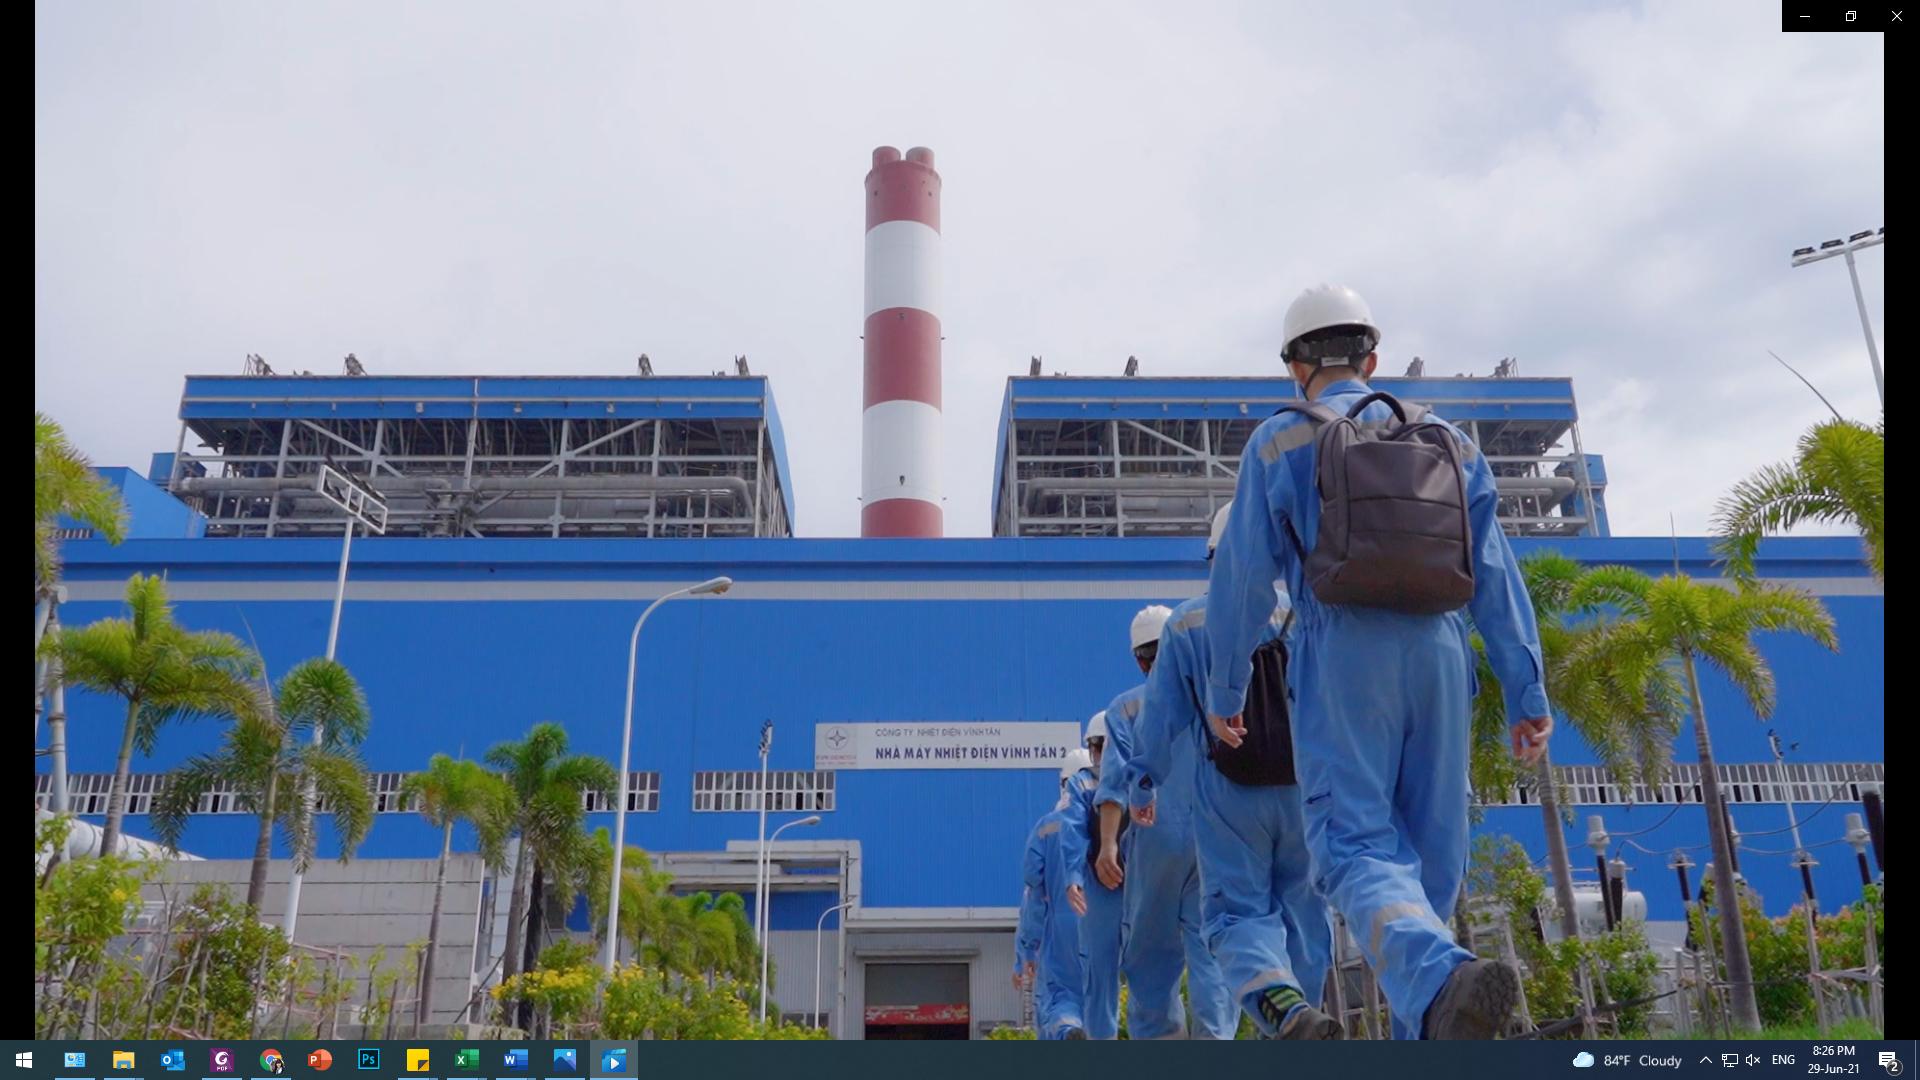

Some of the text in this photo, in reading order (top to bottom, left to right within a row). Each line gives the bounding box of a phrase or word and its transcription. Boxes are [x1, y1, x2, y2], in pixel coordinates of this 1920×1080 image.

[904, 728, 914, 737] TY
[875, 744, 900, 760] NHÀ
[904, 744, 931, 760] MÁY
[935, 744, 968, 762] NHIỆT
[971, 744, 998, 762] ĐIỆN
[1059, 747, 1067, 759] 2
